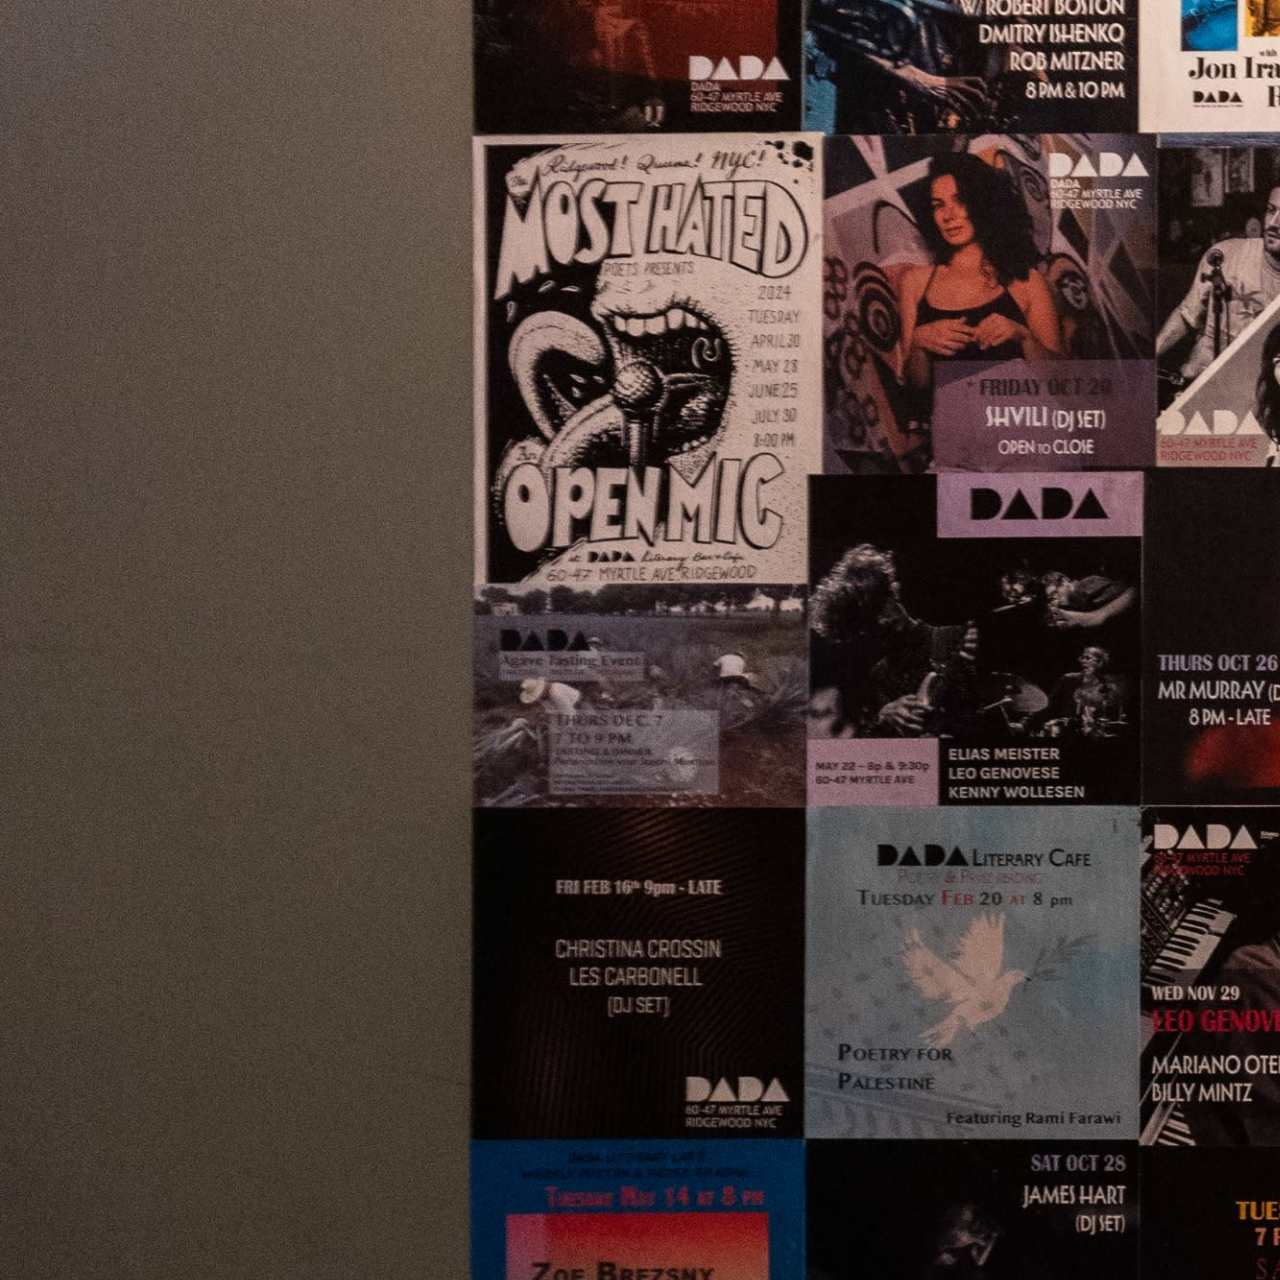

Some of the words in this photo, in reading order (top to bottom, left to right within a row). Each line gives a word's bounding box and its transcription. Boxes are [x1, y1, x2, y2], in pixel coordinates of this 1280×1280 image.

[980, 25, 1044, 44] DMITRY
[1048, 24, 1125, 44] ISHENKO
[1189, 57, 1238, 82] Jon
[495, 169, 638, 299] MOST
[646, 179, 808, 277] HATED
[985, 408, 1047, 429] SHVILI
[1052, 409, 1074, 431] (DJ
[1076, 408, 1107, 430] SET)
[505, 461, 663, 552] OPEN
[666, 453, 785, 549] MIC
[970, 488, 1109, 520] DADA
[1158, 655, 1213, 672] THURS
[1218, 654, 1251, 671] OCT
[1256, 654, 1278, 671] 26
[949, 748, 990, 760] ELIAS
[994, 748, 1060, 760] MEISTER
[949, 787, 999, 799] KENNY
[1003, 786, 1085, 799] WOLLESEN
[555, 940, 643, 959] CHRISTINA
[648, 939, 722, 958] CROSSIN
[1152, 1055, 1241, 1075] MARIANO
[1152, 1083, 1195, 1103] BILLY
[1199, 1083, 1253, 1102] MINTZ
